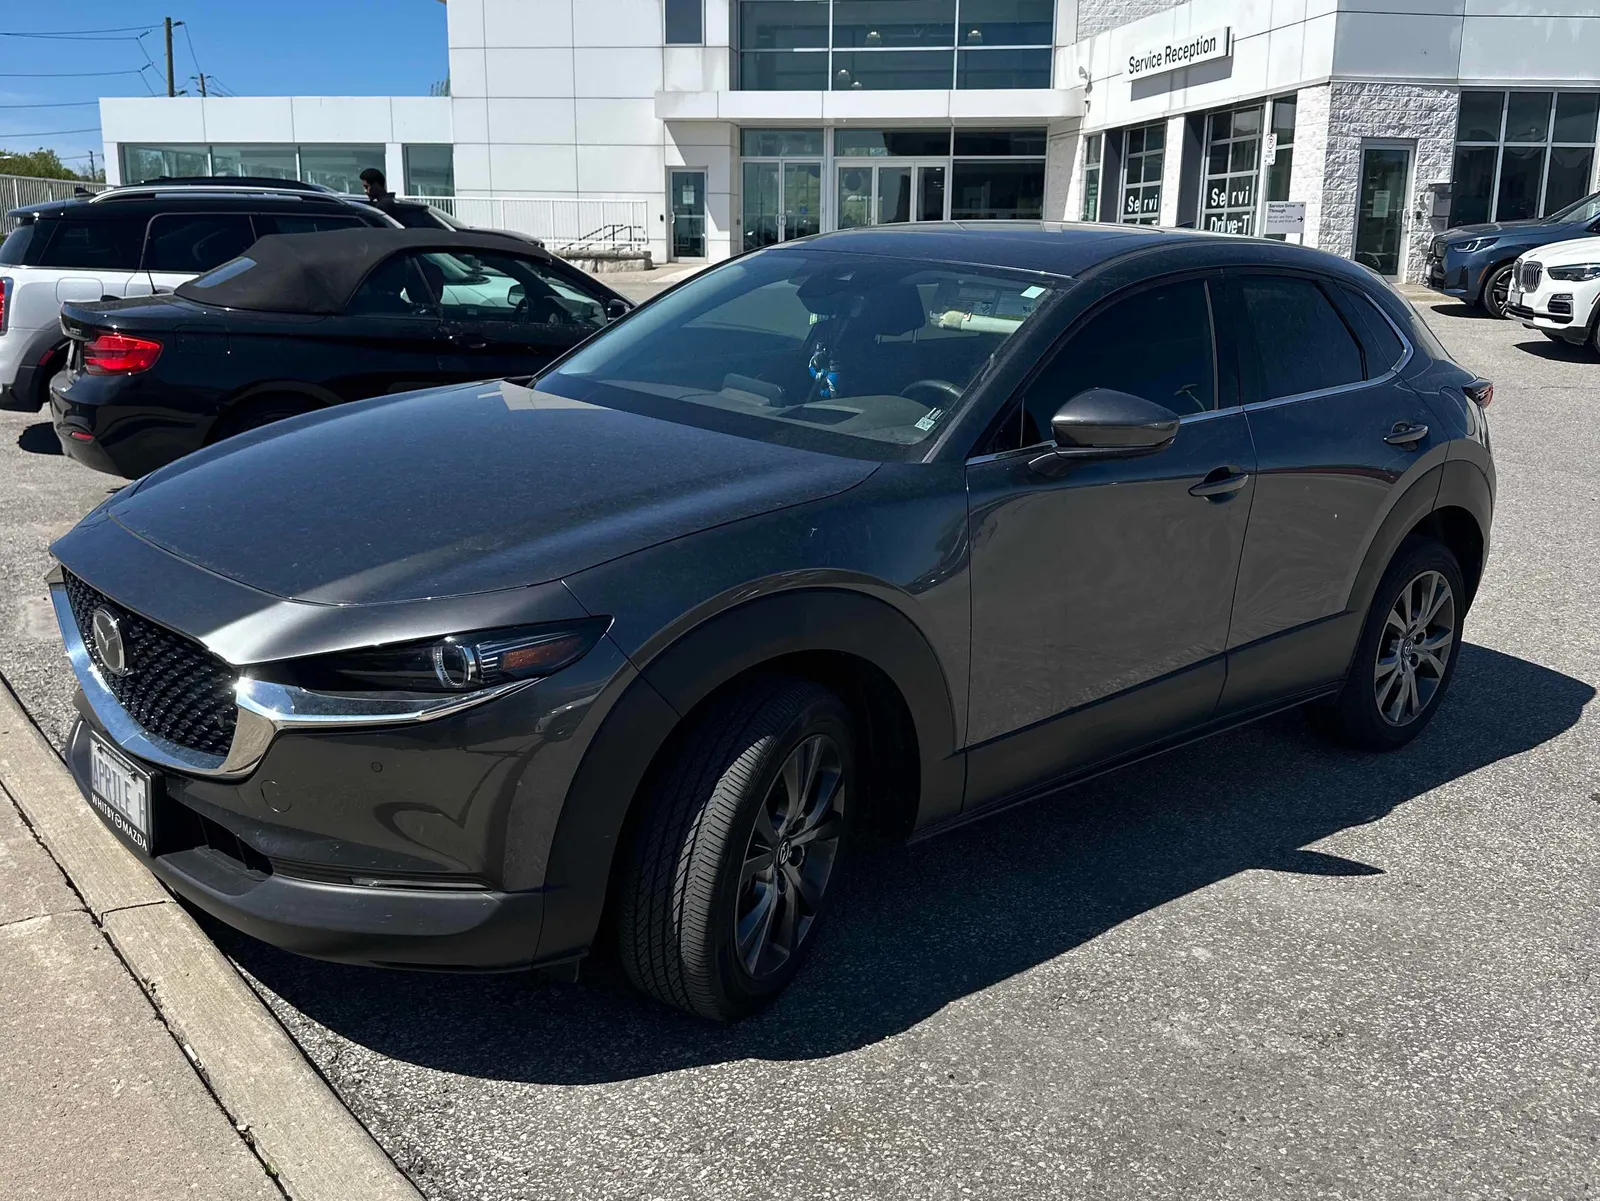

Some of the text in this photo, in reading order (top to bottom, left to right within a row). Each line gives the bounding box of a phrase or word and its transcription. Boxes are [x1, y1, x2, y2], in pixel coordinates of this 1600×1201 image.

[1128, 35, 1216, 75] Service Reception
[91, 754, 132, 819] APRILE
[91, 792, 148, 852] WHITBY MAZDA
